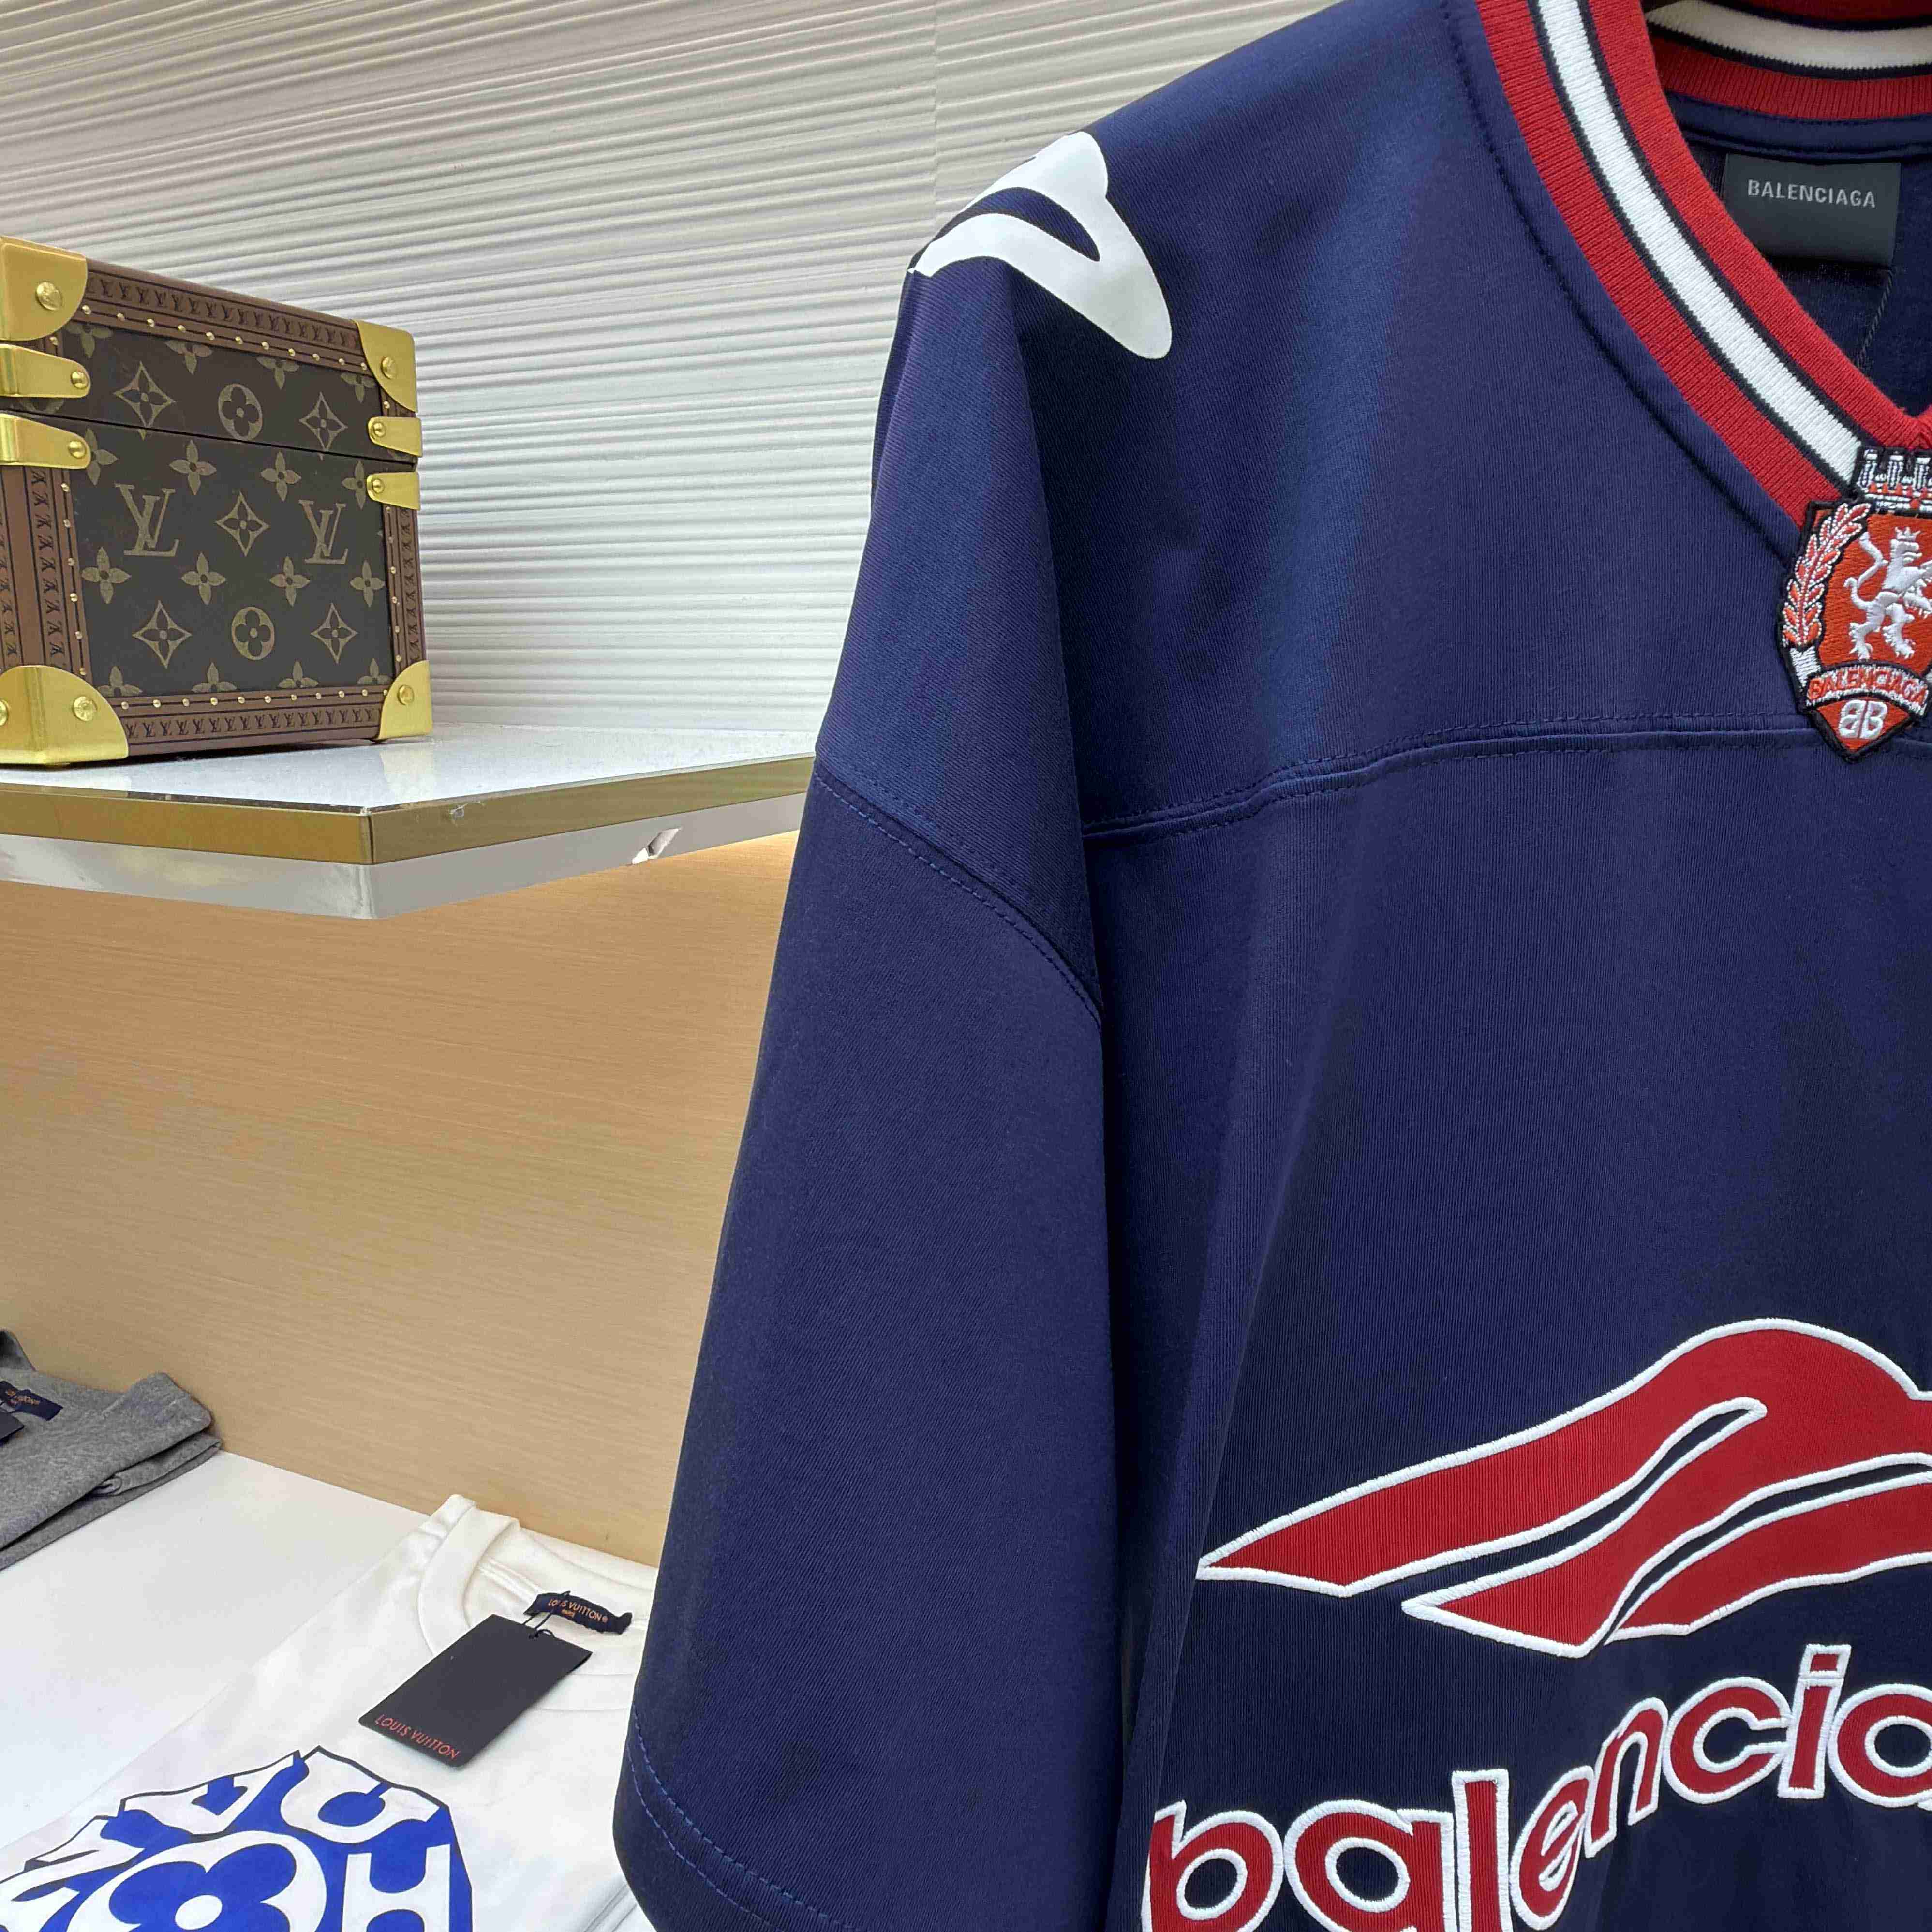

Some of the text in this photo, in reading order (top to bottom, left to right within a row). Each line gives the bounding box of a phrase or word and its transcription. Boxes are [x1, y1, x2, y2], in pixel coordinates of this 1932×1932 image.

[1747, 178, 1876, 208] BALENCIAGA
[375, 1714, 460, 1759] LOUIS VUITTON
